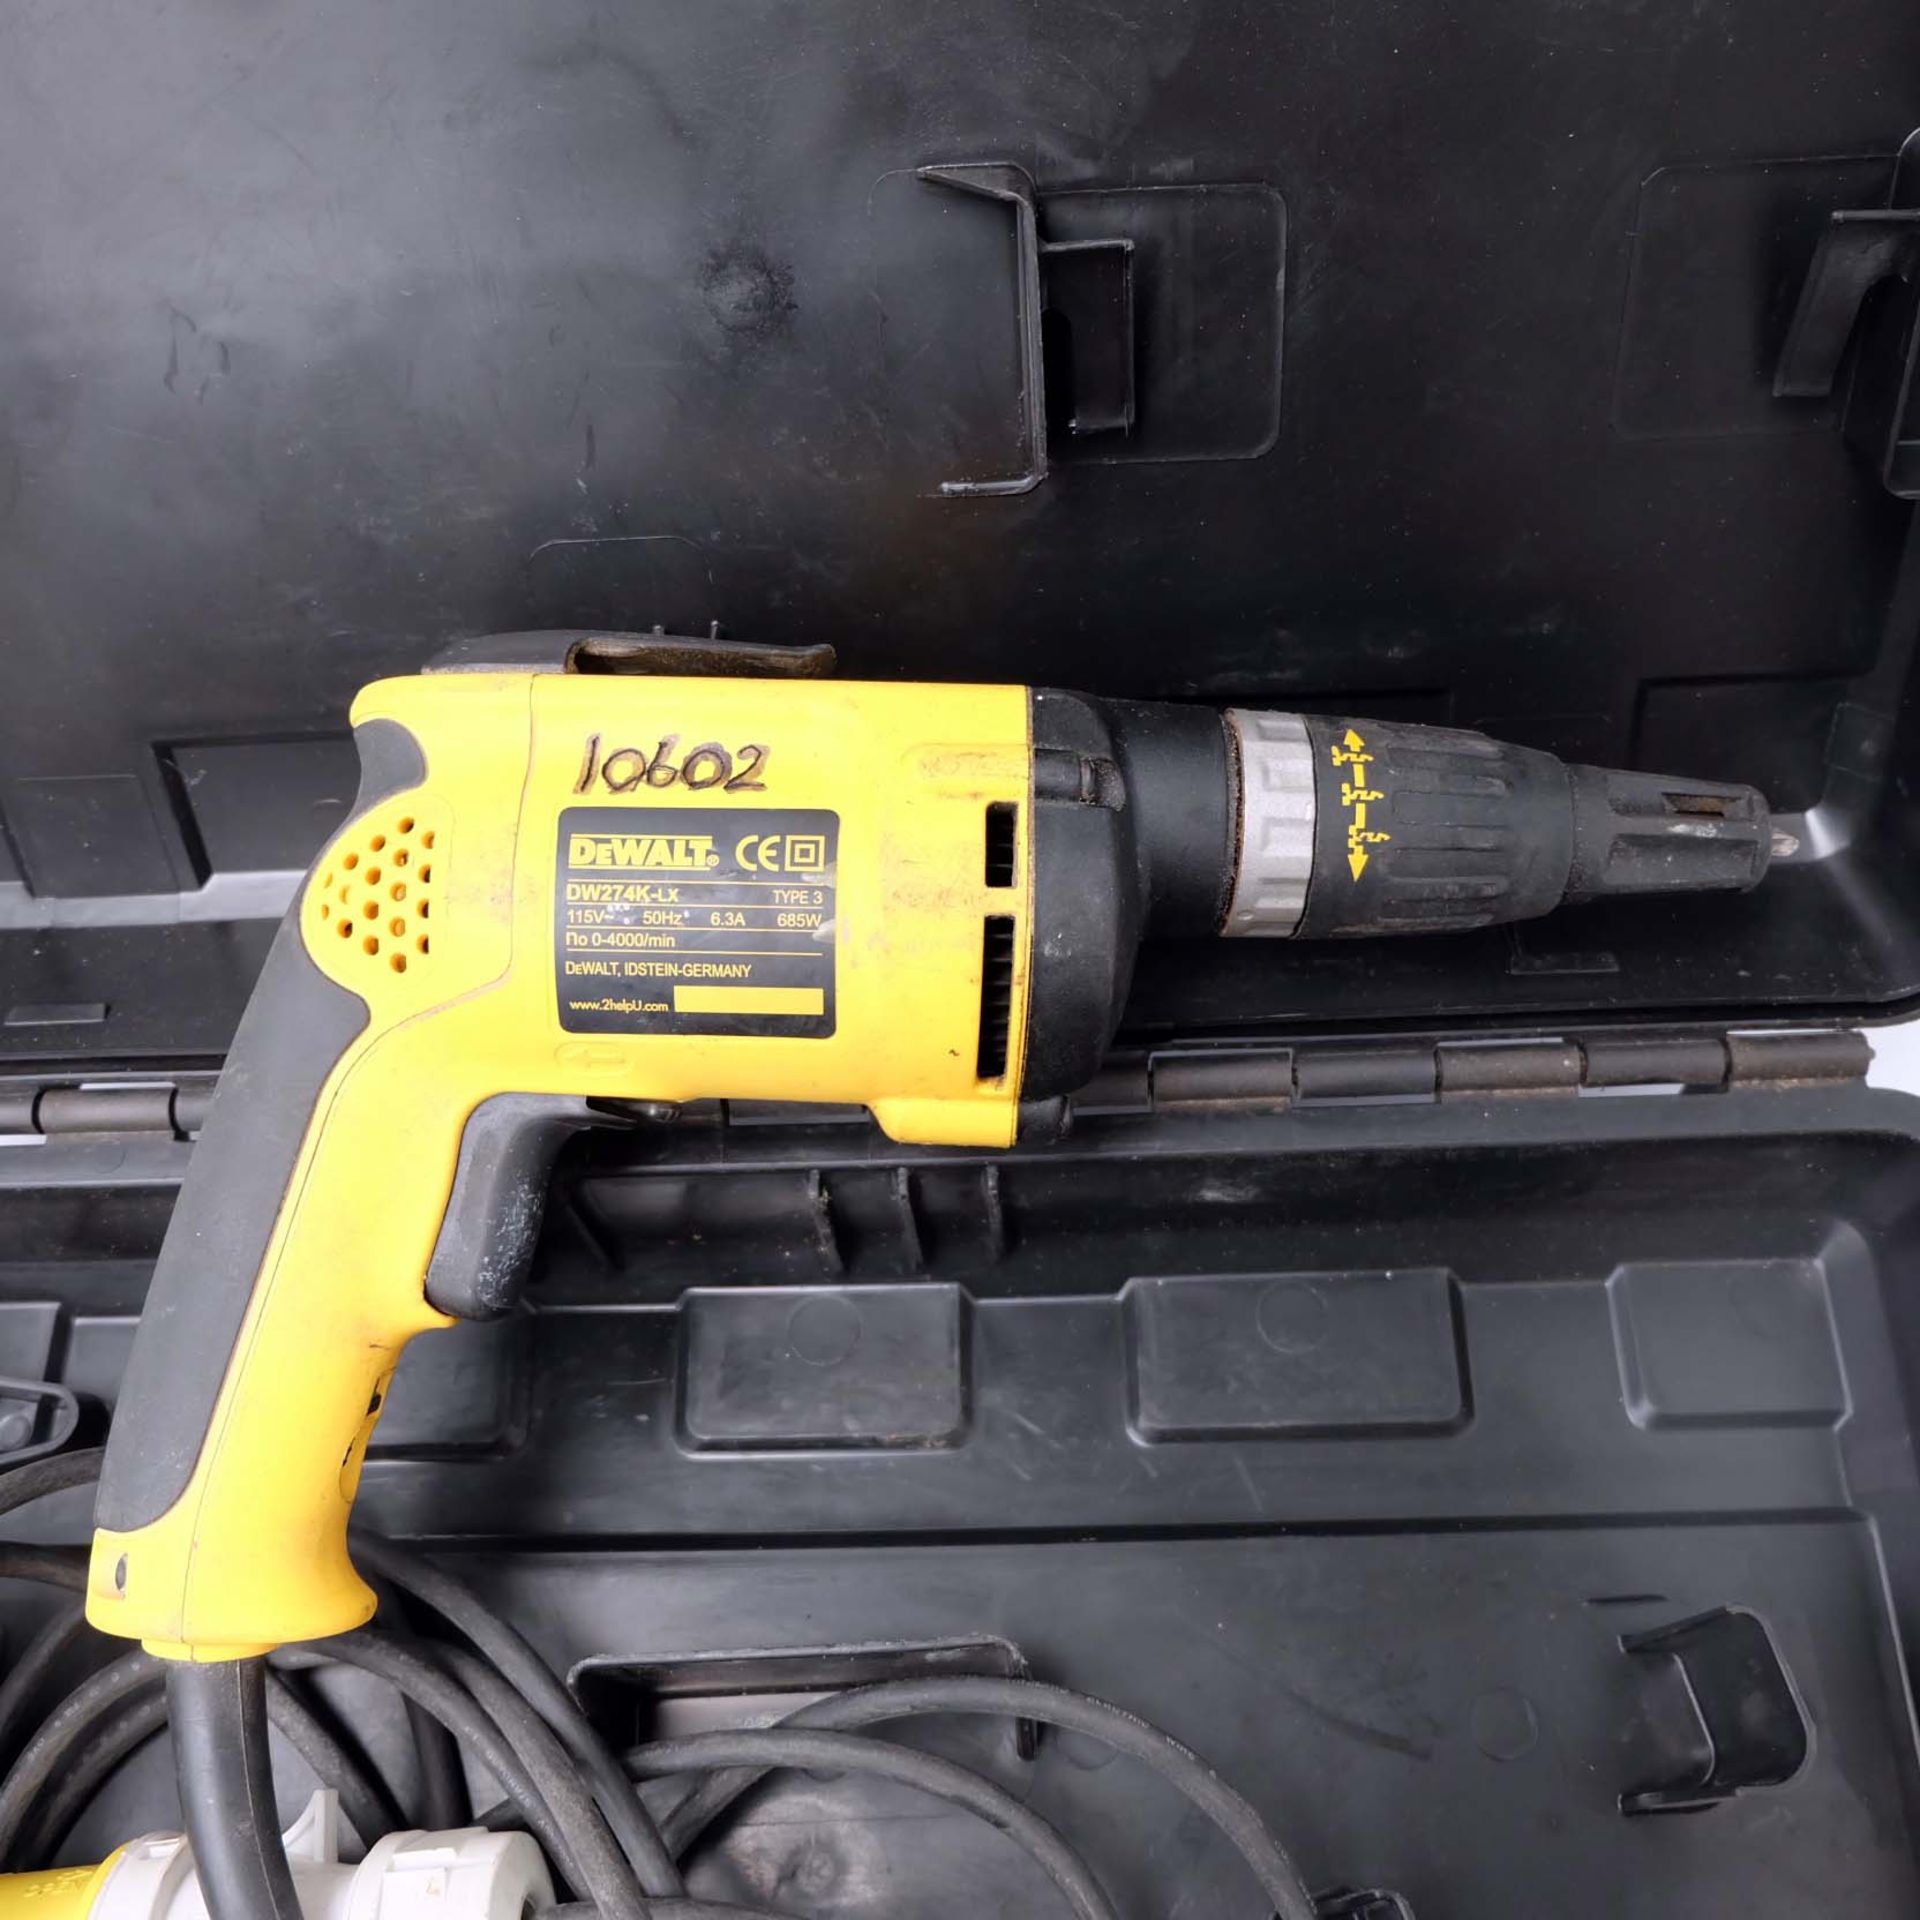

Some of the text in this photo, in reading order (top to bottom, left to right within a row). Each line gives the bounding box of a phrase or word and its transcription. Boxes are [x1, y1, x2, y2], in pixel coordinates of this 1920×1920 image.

[573, 733, 770, 794] 10602
[566, 883, 823, 905] DW274K-LX TYPE 3
[642, 910, 683, 925] 50Hz
[710, 911, 746, 927] 6.3A
[777, 913, 822, 928] 685W
[591, 932, 676, 948] 0-4000/min
[624, 962, 751, 978] IDSTEIN-GERMANY
[568, 998, 669, 1014] www.2helpU.com
